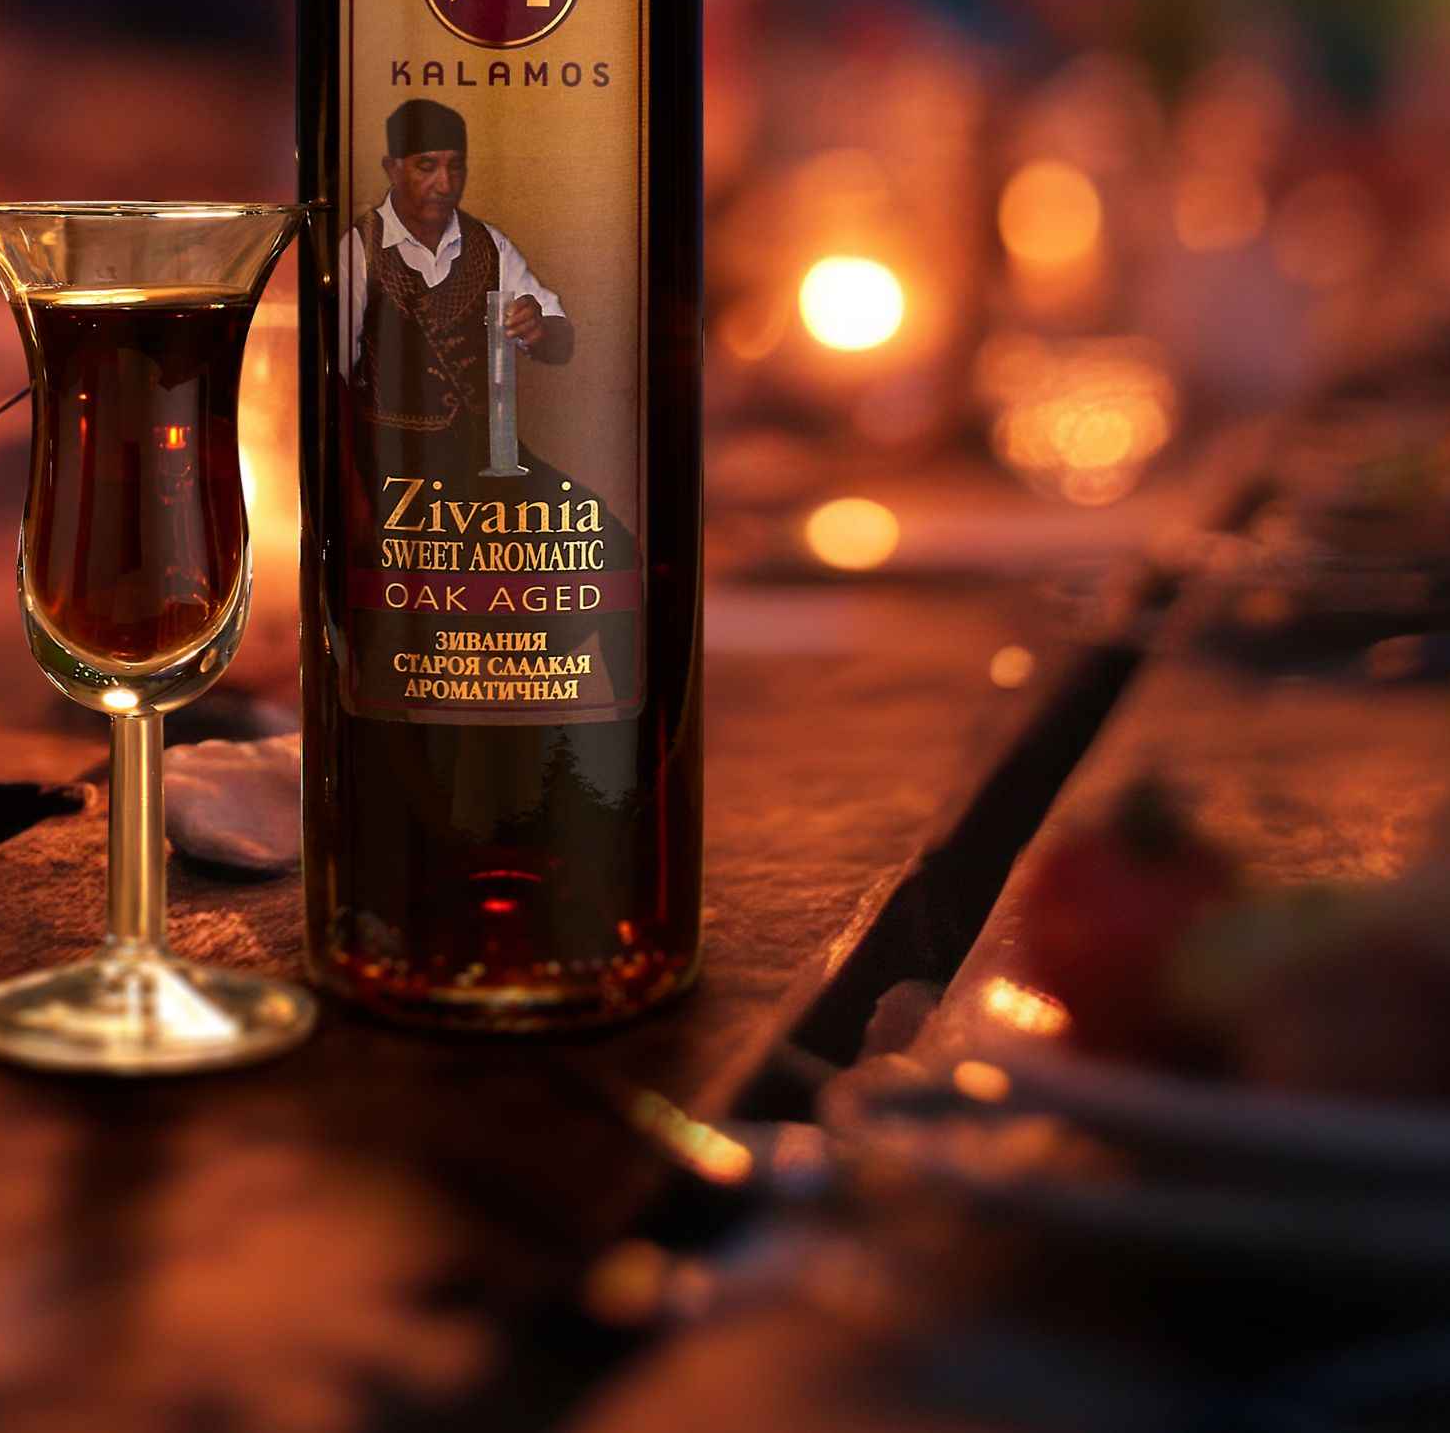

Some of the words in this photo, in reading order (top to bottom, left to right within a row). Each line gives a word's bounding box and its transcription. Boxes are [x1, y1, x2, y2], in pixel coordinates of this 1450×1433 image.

[391, 60, 611, 88] KALAMOS
[381, 476, 604, 535] Zivania
[381, 538, 464, 571] SWEET
[469, 540, 605, 572] AROMATIC
[385, 582, 468, 612] OAK
[487, 584, 602, 612] AGED
[435, 631, 548, 652] ЗИВАНИЯ
[393, 653, 481, 676] СТАРОЯ
[487, 654, 592, 680] СЛАДКАЯ
[404, 678, 579, 701] АРОМАТИЧНАЯ
